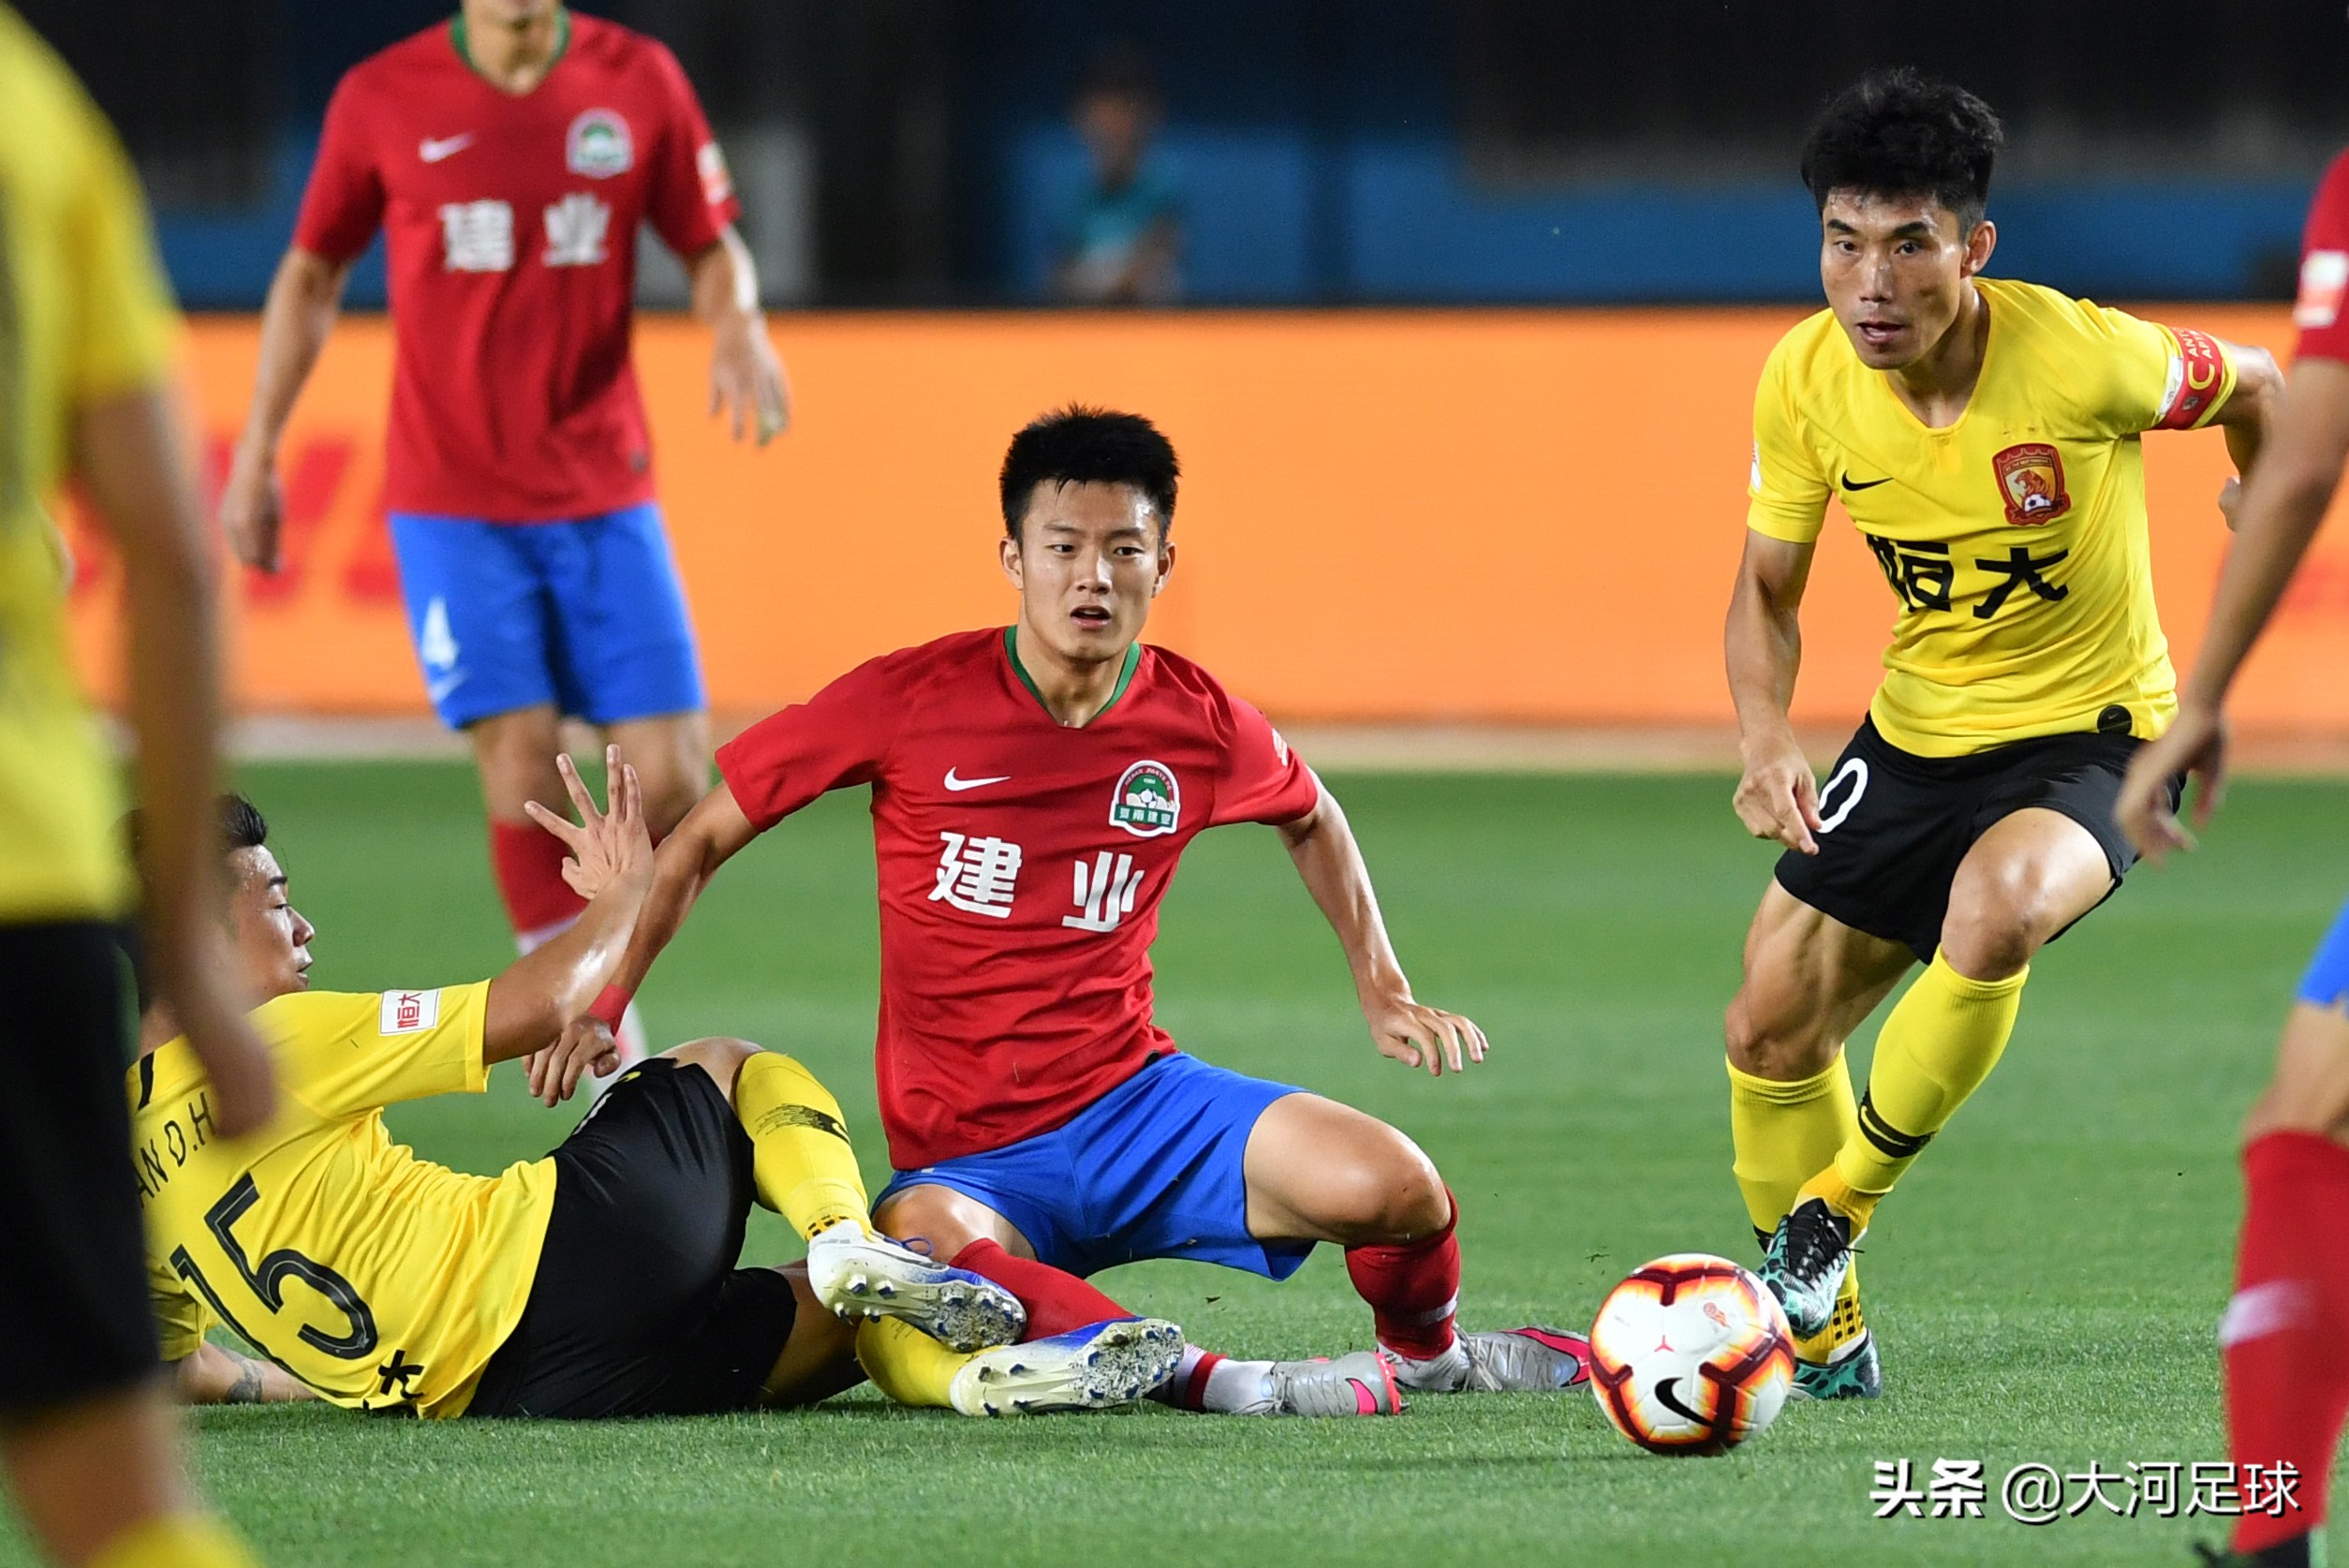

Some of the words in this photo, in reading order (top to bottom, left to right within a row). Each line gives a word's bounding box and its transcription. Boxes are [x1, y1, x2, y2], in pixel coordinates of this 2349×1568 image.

[436, 192, 613, 273] 建业
[1866, 533, 2069, 619] 恒大
[927, 831, 1145, 932] 建业
[170, 1173, 378, 1397] 15
